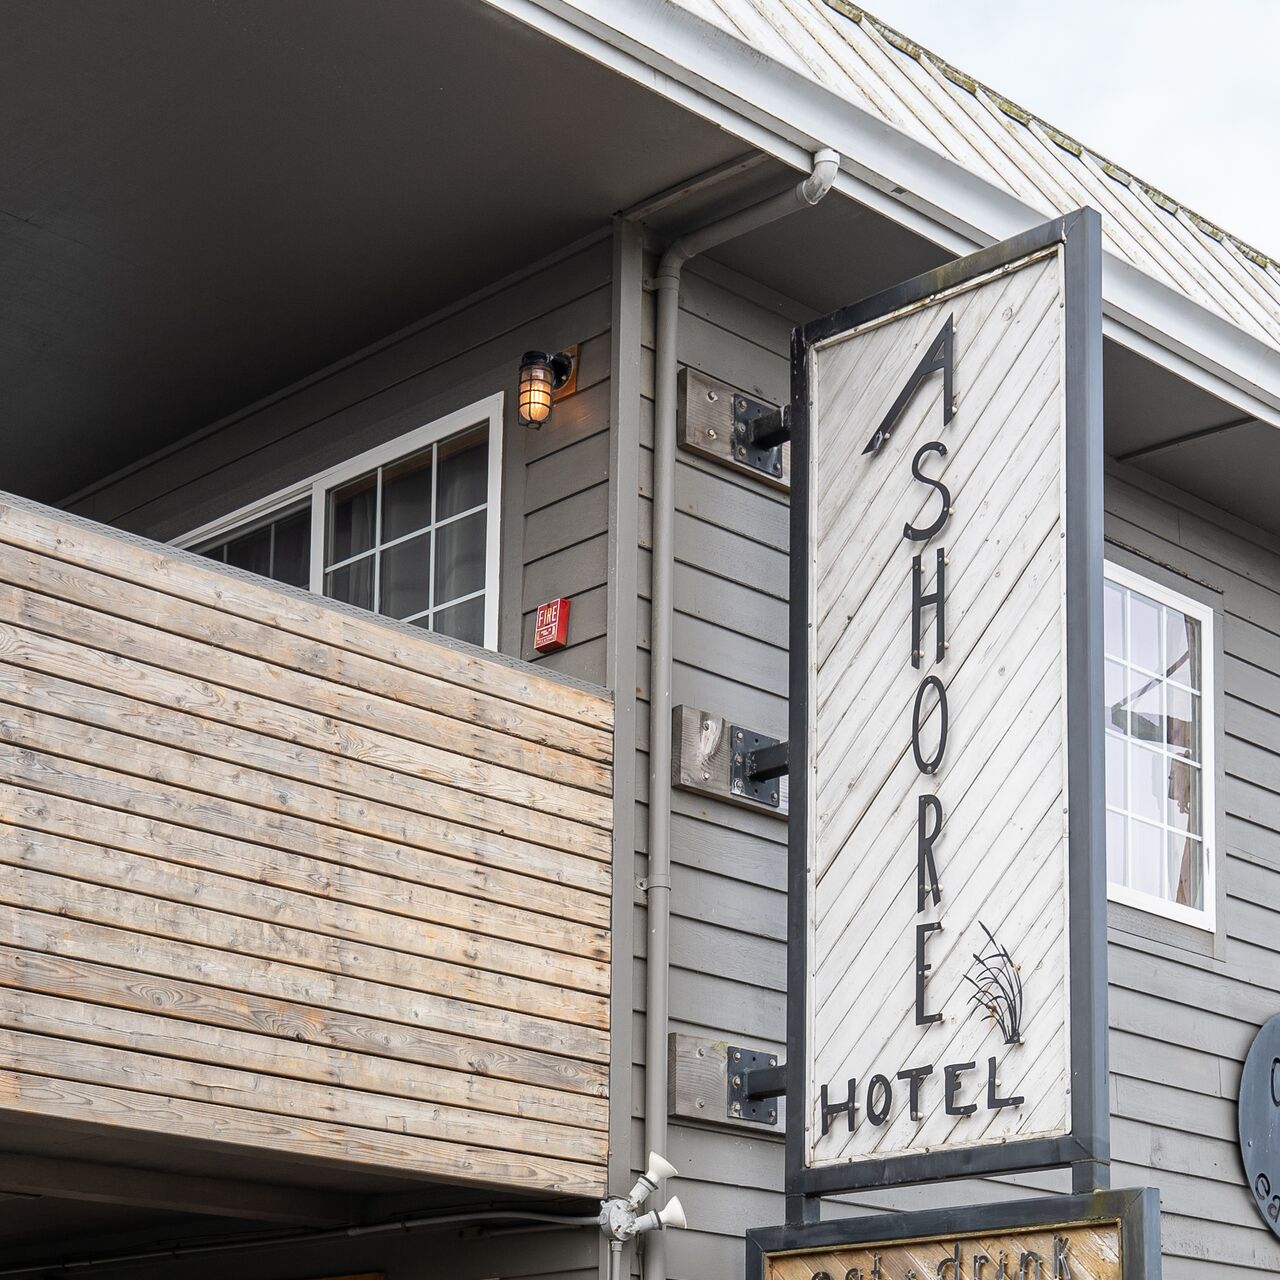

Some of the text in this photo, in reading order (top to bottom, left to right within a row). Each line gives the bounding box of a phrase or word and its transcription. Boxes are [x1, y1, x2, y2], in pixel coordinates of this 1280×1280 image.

[539, 605, 558, 626] FIRE
[861, 312, 955, 1026] ASHORE
[820, 1056, 1025, 1136] HOTEL
